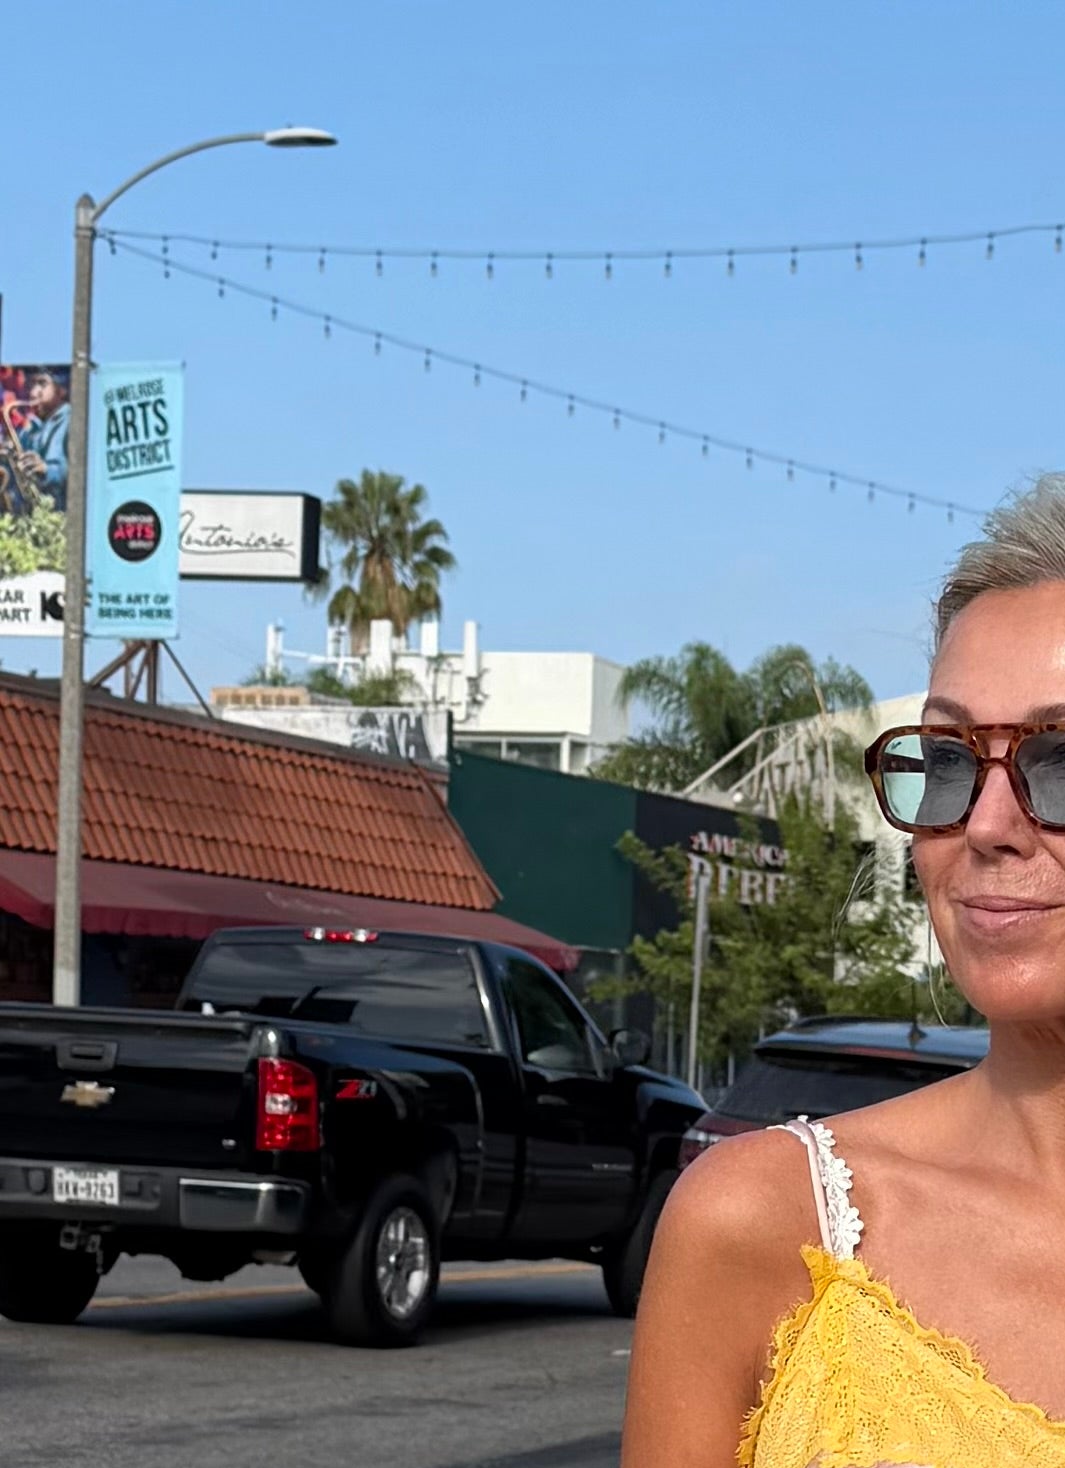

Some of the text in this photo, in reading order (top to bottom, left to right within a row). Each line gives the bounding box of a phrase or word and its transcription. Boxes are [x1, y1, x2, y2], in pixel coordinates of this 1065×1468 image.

[106, 399, 169, 446] ARTS
[106, 439, 172, 472] DISTRICT
[98, 593, 170, 605] THE ART OF
[98, 608, 173, 620] BEING HERE
